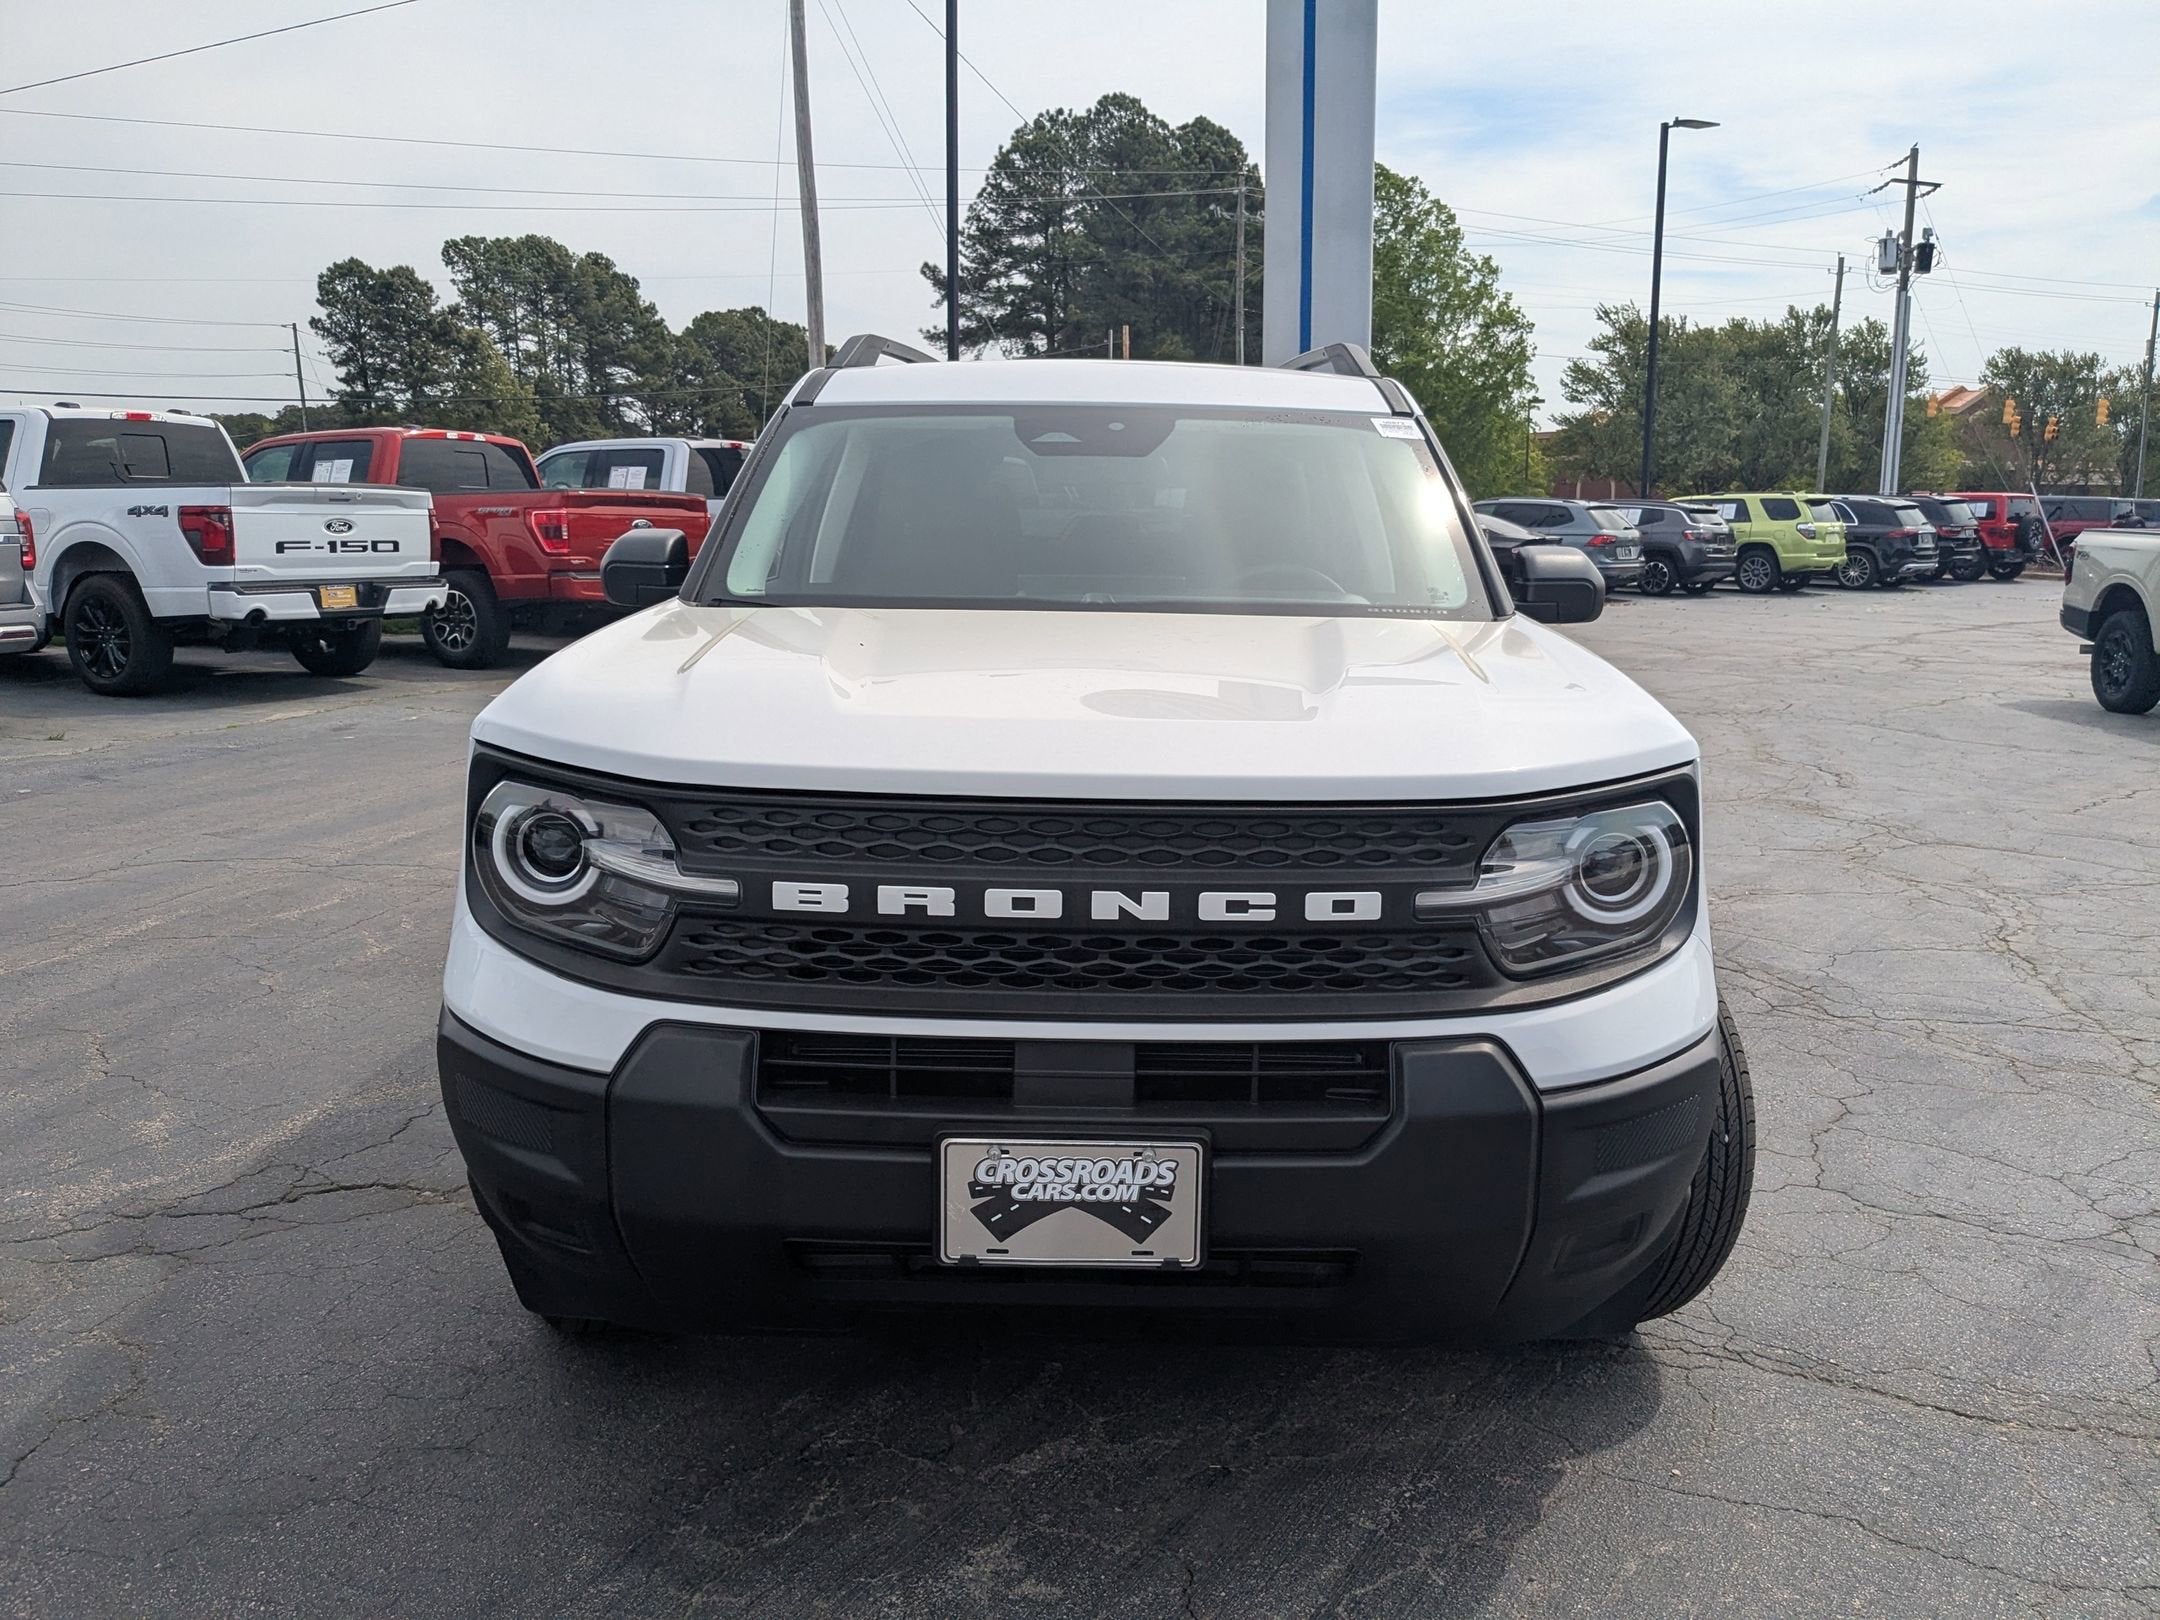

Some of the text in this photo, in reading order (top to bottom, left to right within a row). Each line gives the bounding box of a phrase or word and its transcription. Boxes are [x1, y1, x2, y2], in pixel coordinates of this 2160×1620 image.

[329, 520, 349, 532] Ford
[275, 540, 400, 554] F-150
[772, 880, 1382, 922] BRONCO
[974, 1157, 1177, 1187] CROSSROADS
[1010, 1183, 1141, 1203] CARS.COM
